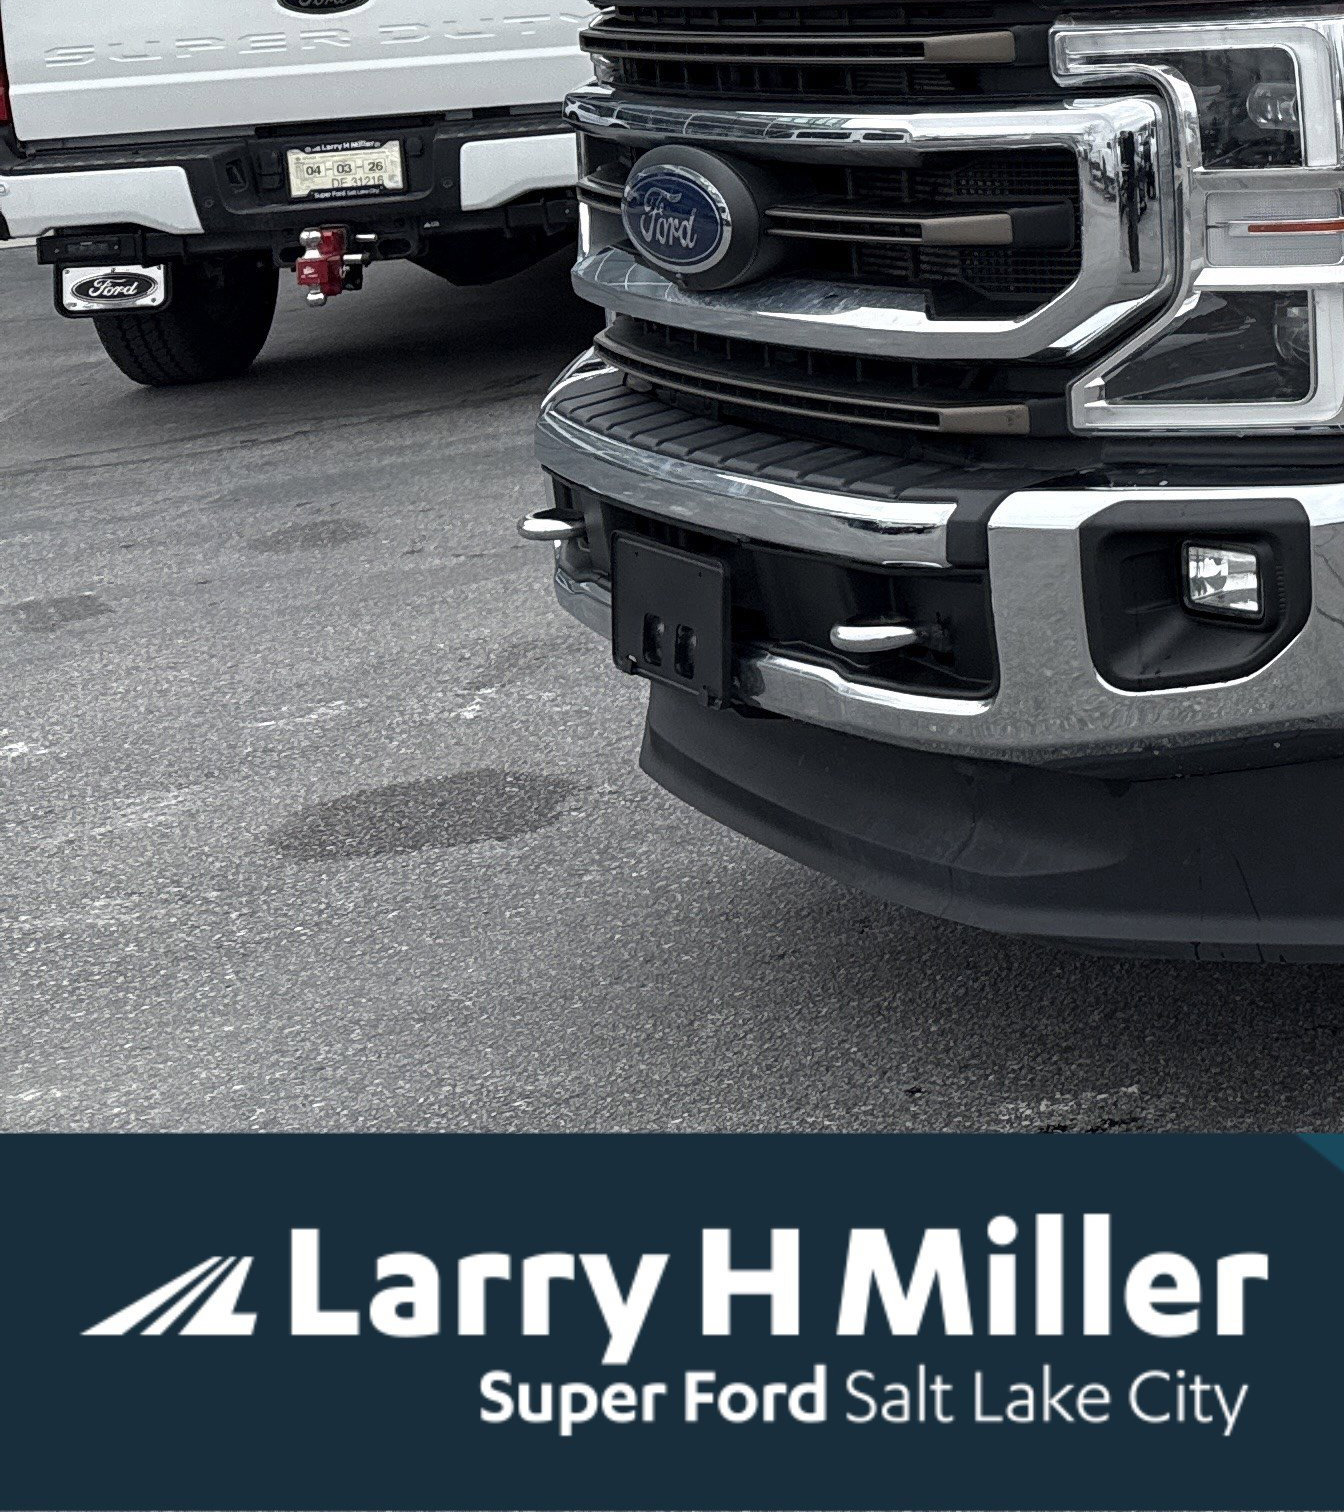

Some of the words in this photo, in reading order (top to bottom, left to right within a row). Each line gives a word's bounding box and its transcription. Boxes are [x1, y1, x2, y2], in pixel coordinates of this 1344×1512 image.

[44, 28, 353, 68] SUPER
[367, 161, 384, 172] 26
[640, 187, 698, 249] Ford
[88, 278, 139, 297] Ford
